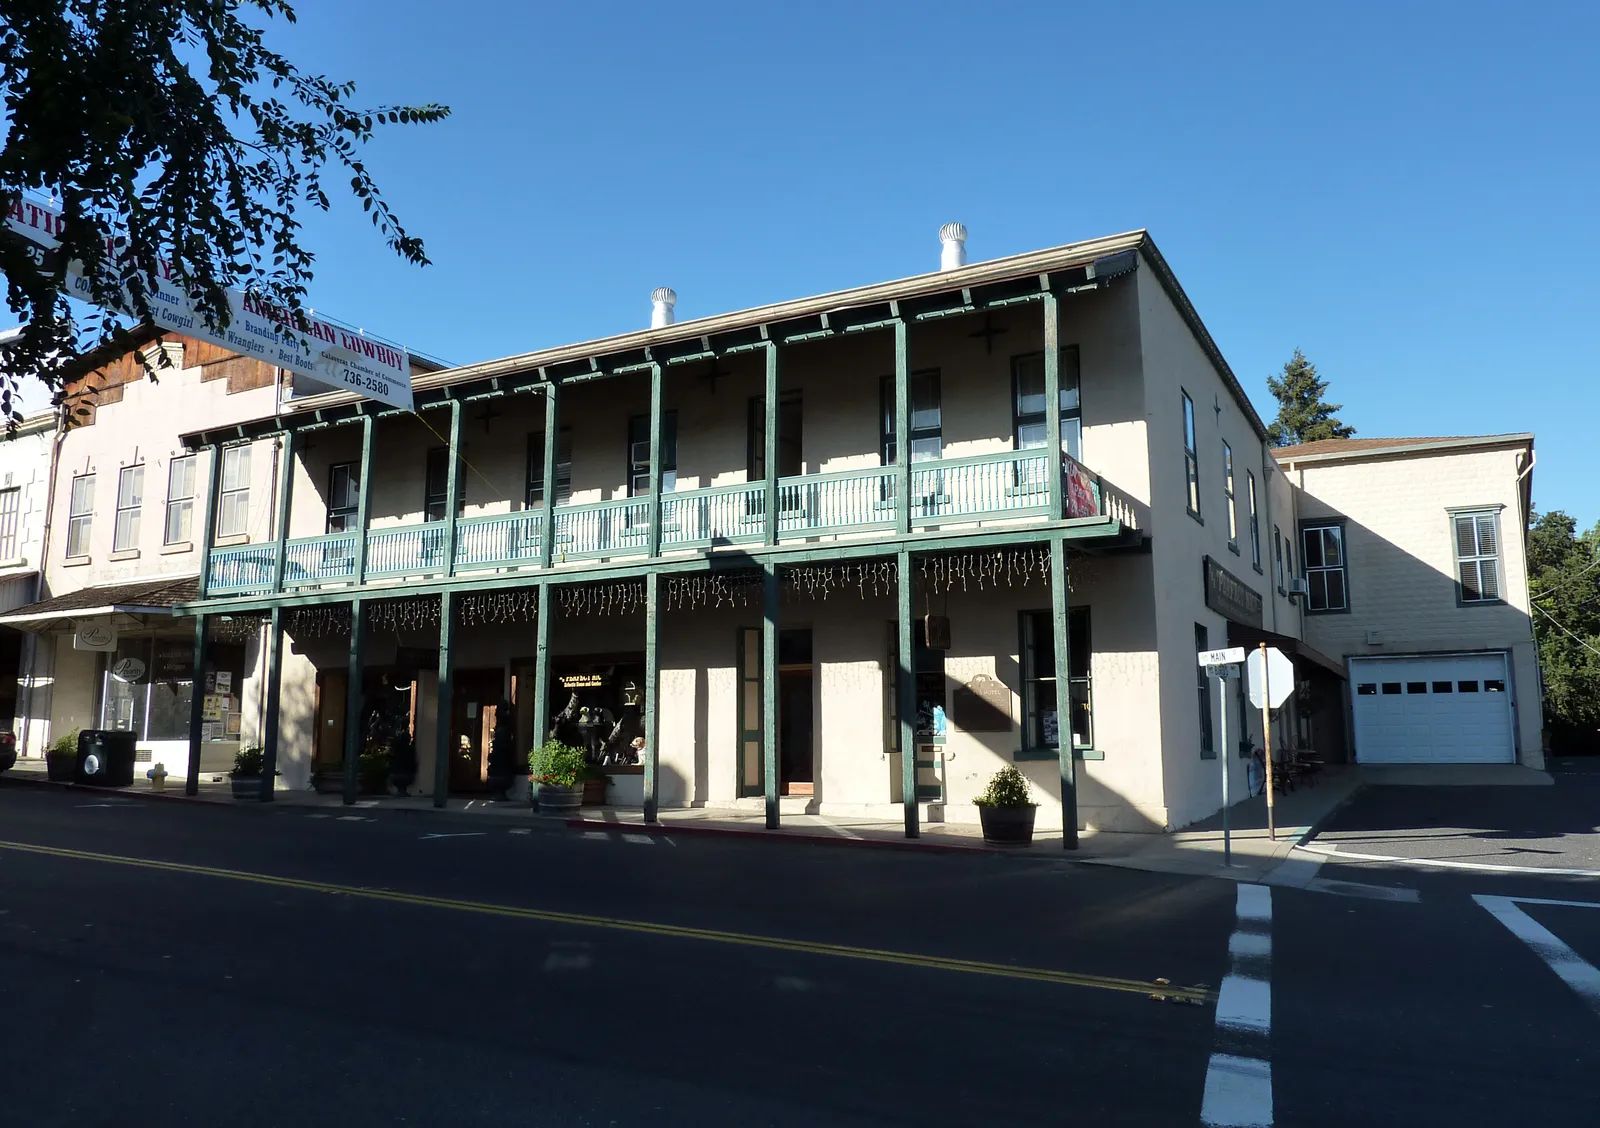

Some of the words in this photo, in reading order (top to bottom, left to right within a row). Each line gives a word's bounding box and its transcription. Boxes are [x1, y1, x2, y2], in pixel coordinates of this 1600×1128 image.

[162, 307, 194, 328] Cowgirl
[228, 330, 265, 353] Wranglers
[278, 349, 293, 363] Best
[295, 359, 313, 370] Boots
[245, 320, 279, 345] Branding
[281, 334, 300, 352] Party
[341, 332, 403, 371] COWBOY
[321, 351, 348, 366] Calaveras
[350, 361, 374, 375] Chamber
[381, 373, 407, 388] Commerce
[343, 368, 389, 396] 736-2580
[1210, 651, 1226, 662] MAIN
